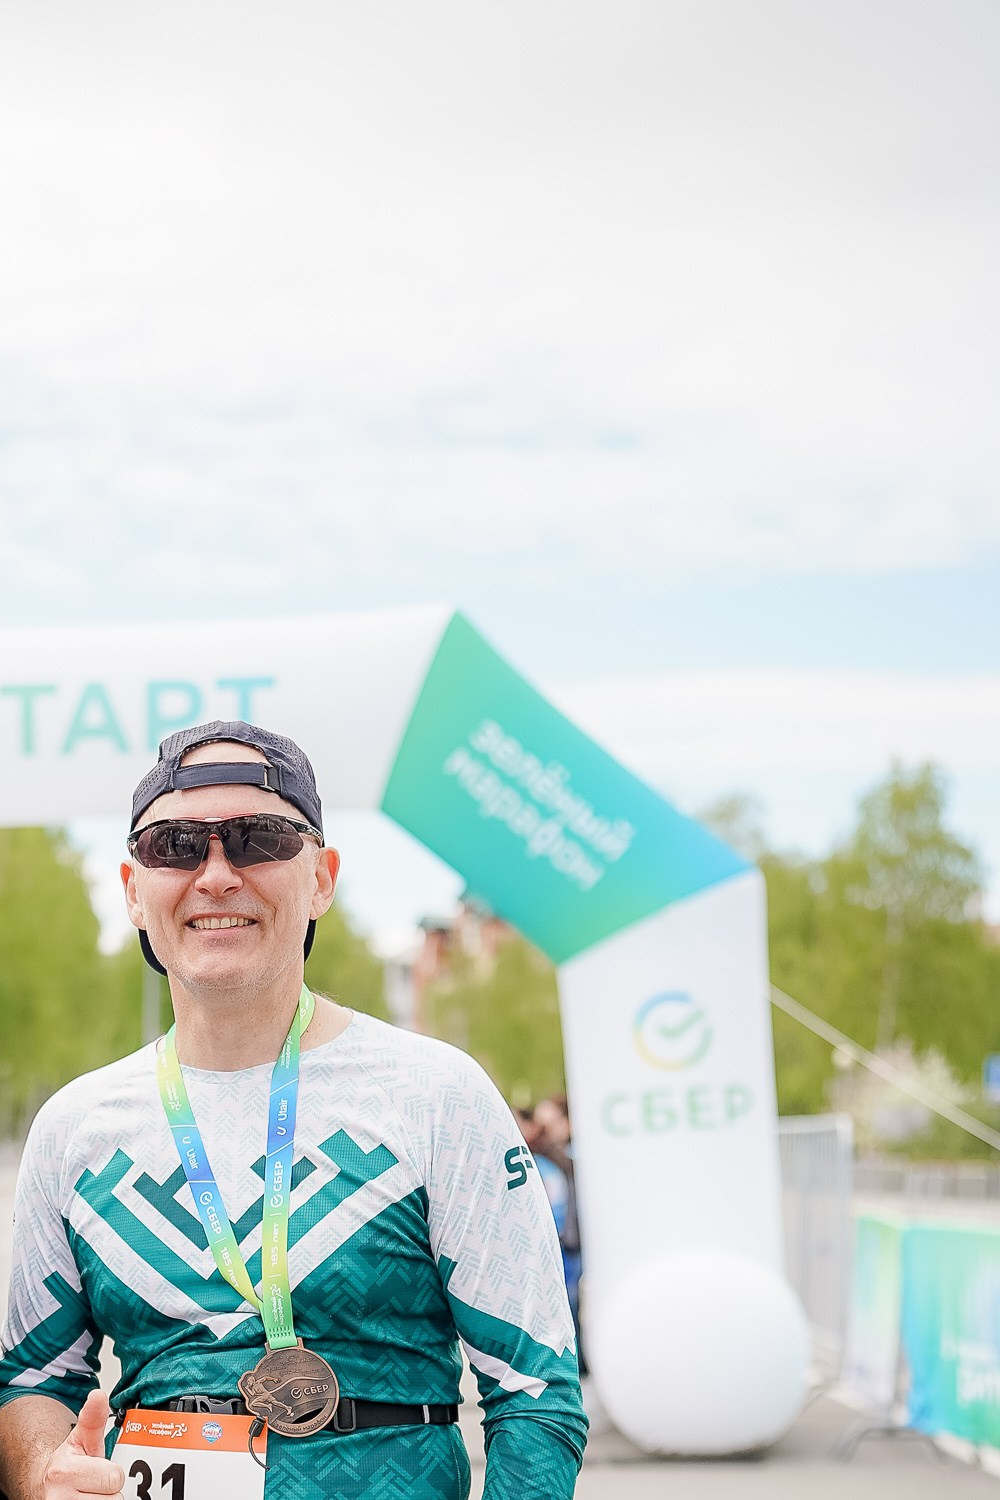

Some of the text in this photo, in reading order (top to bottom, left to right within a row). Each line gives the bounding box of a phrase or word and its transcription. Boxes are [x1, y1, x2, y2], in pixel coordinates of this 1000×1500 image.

[278, 1098, 289, 1121] Utair
[601, 1082, 755, 1137] СБЕР
[186, 1148, 199, 1170] Utair
[273, 1160, 284, 1192] СБЕР
[206, 1206, 222, 1235] СБЕР
[220, 1247, 232, 1267] 185
[271, 1247, 280, 1267] 185
[304, 1384, 329, 1395] СБЕР
